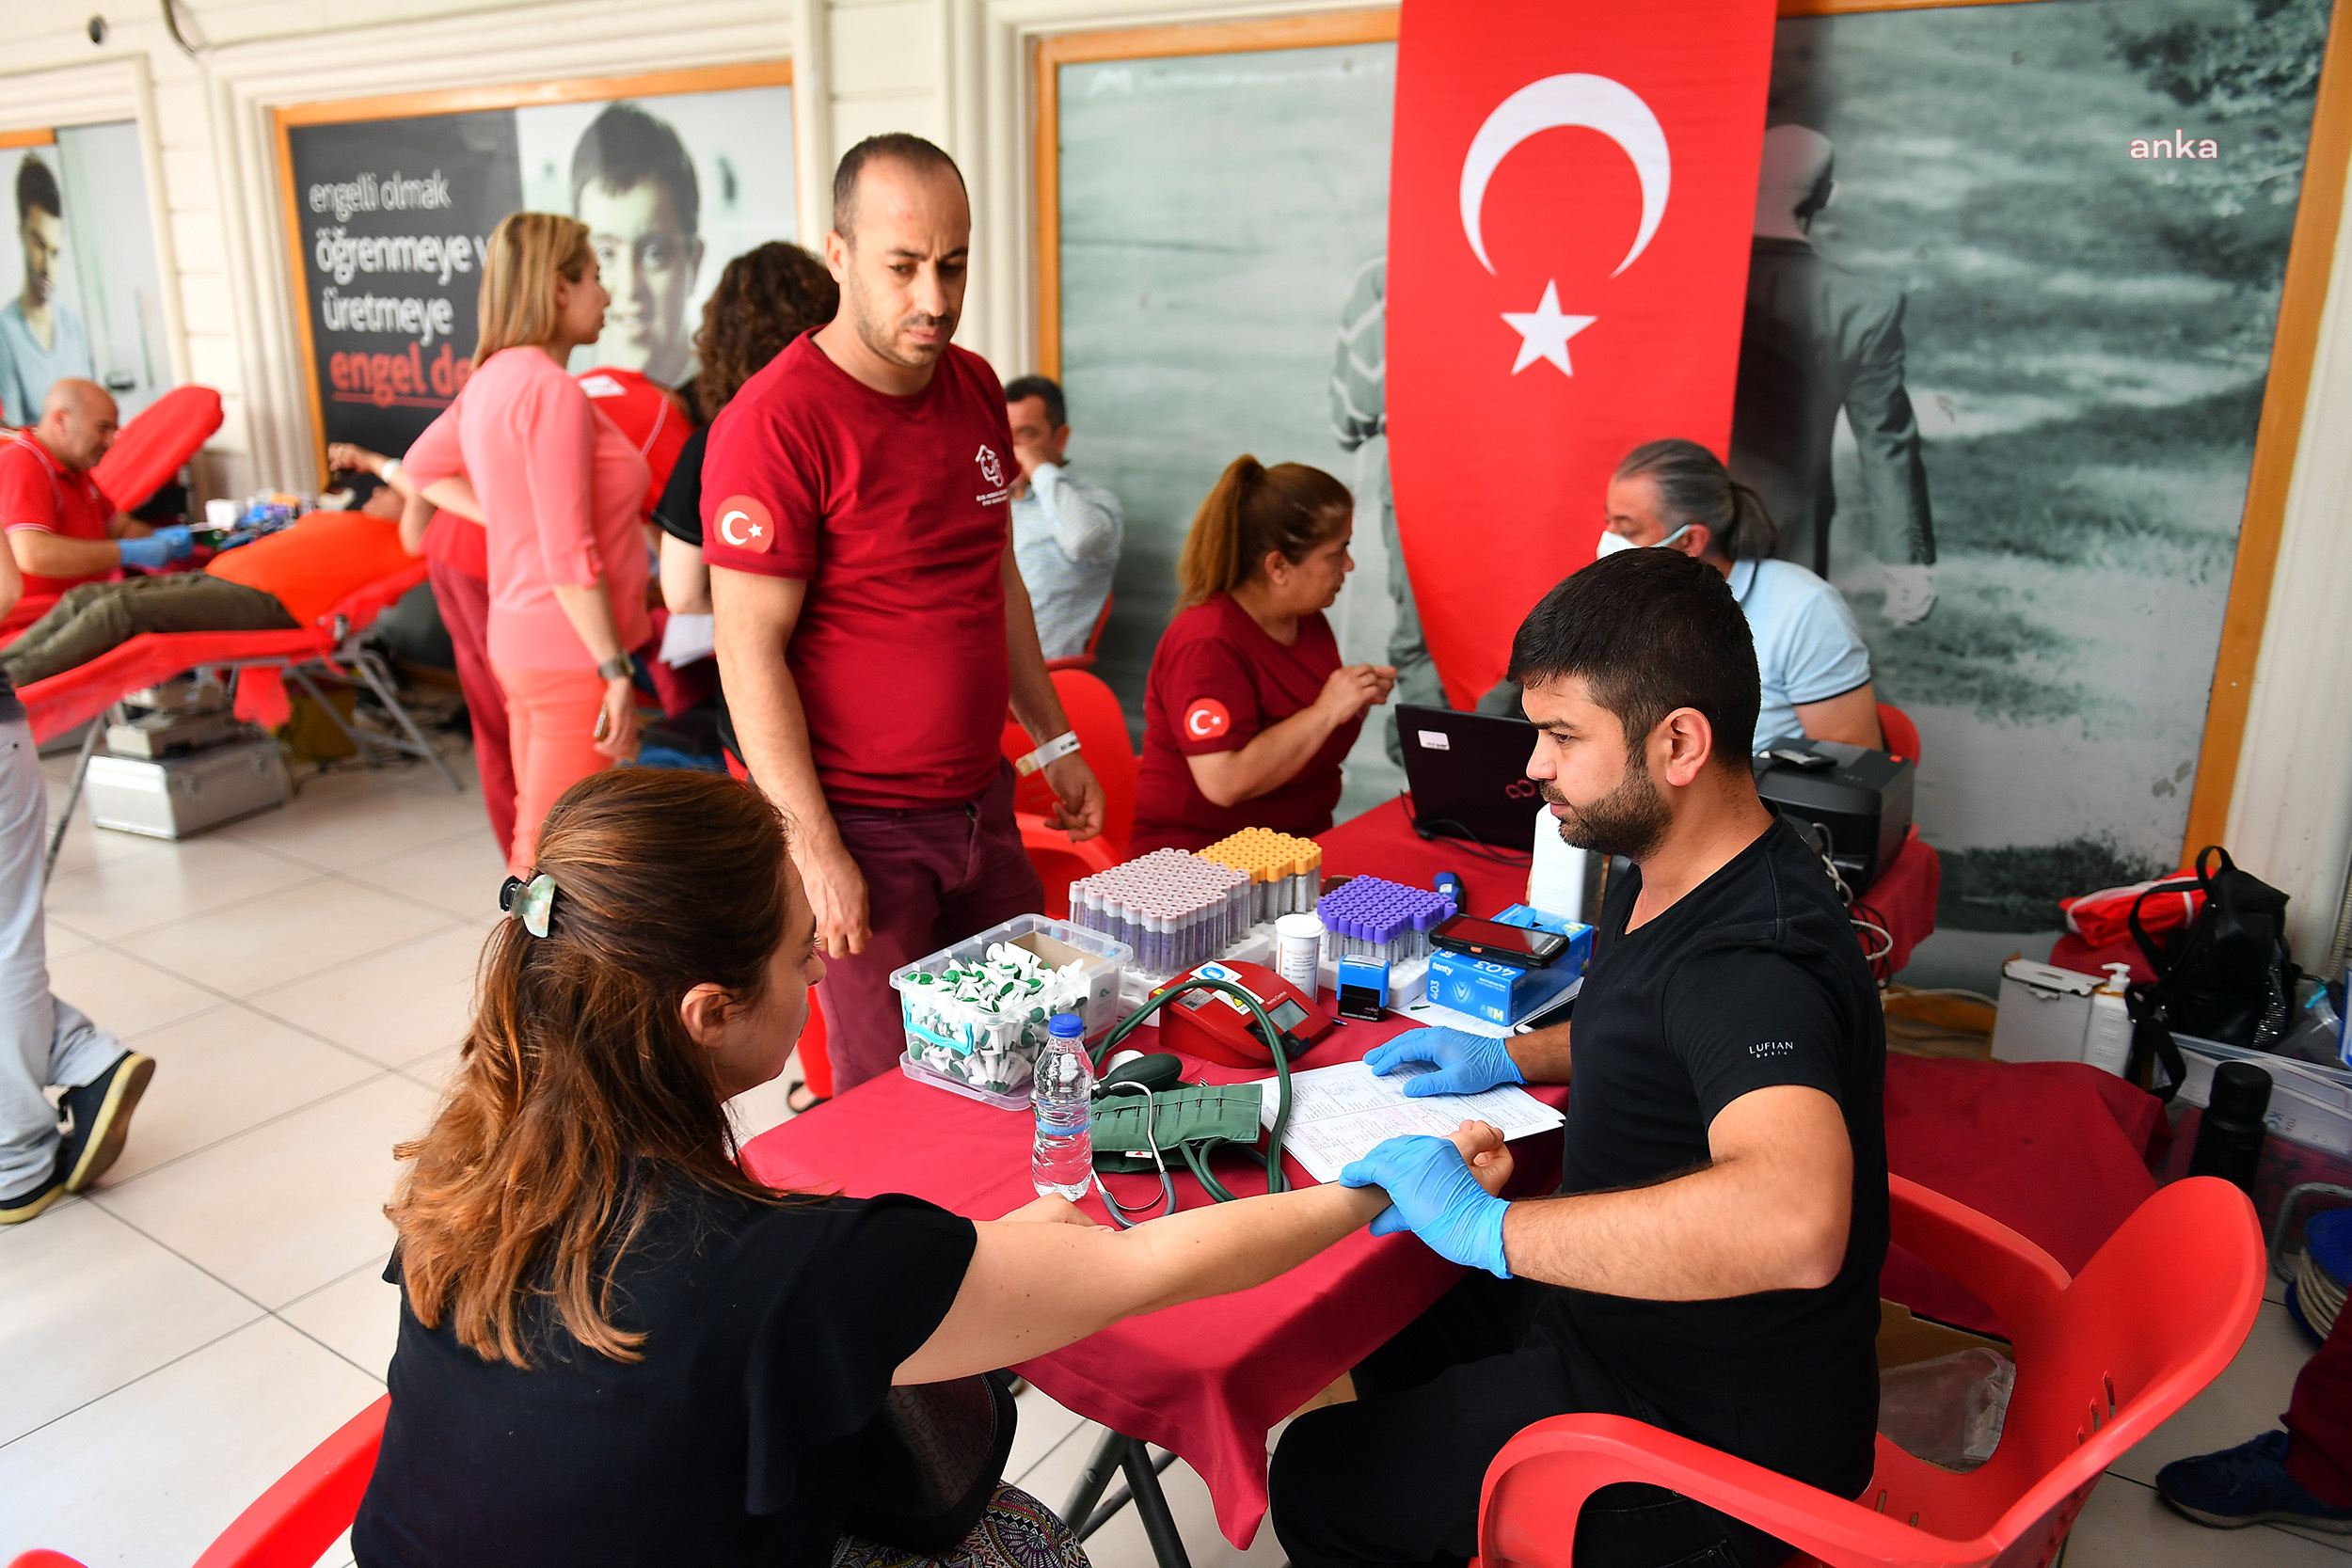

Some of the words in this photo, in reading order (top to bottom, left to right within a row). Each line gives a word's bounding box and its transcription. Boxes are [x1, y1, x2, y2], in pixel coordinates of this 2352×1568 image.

[309, 171, 380, 223] engelli
[380, 167, 453, 211] olmak
[315, 226, 473, 287] öğrenmeye
[322, 286, 454, 347] üretmeye
[330, 341, 429, 408] engel
[1432, 961, 1454, 976] tenty
[1472, 960, 1517, 976] 403
[1749, 1041, 1793, 1054] LUFIAN
